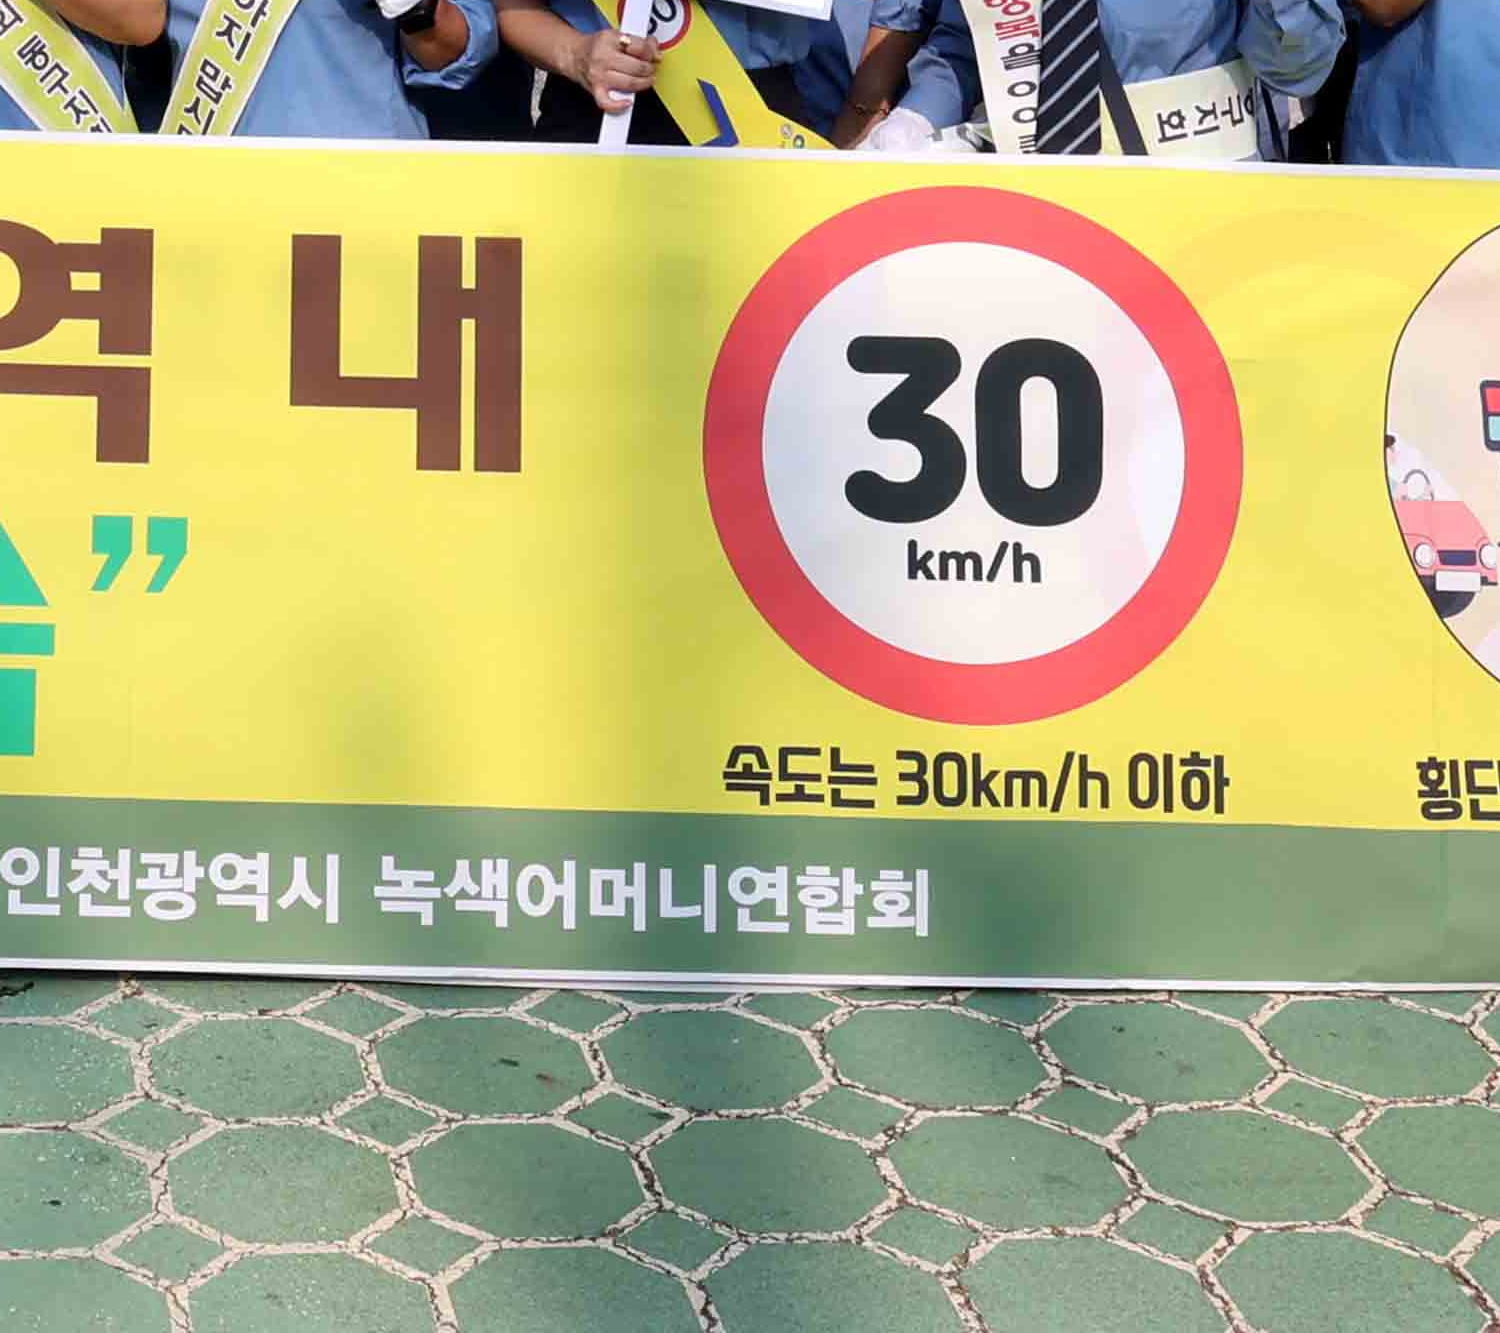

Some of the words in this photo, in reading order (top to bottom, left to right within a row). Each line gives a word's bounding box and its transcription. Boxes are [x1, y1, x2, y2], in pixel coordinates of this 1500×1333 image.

[290, 234, 524, 474] 내
[844, 336, 1105, 527] 30
[906, 539, 1043, 584] km/h
[721, 745, 879, 807] 속도는
[895, 750, 1111, 813] 30km/h
[1128, 751, 1231, 816] 이하
[0, 847, 341, 925] 인천광역시
[373, 855, 931, 939] 녹색어머니연합회
